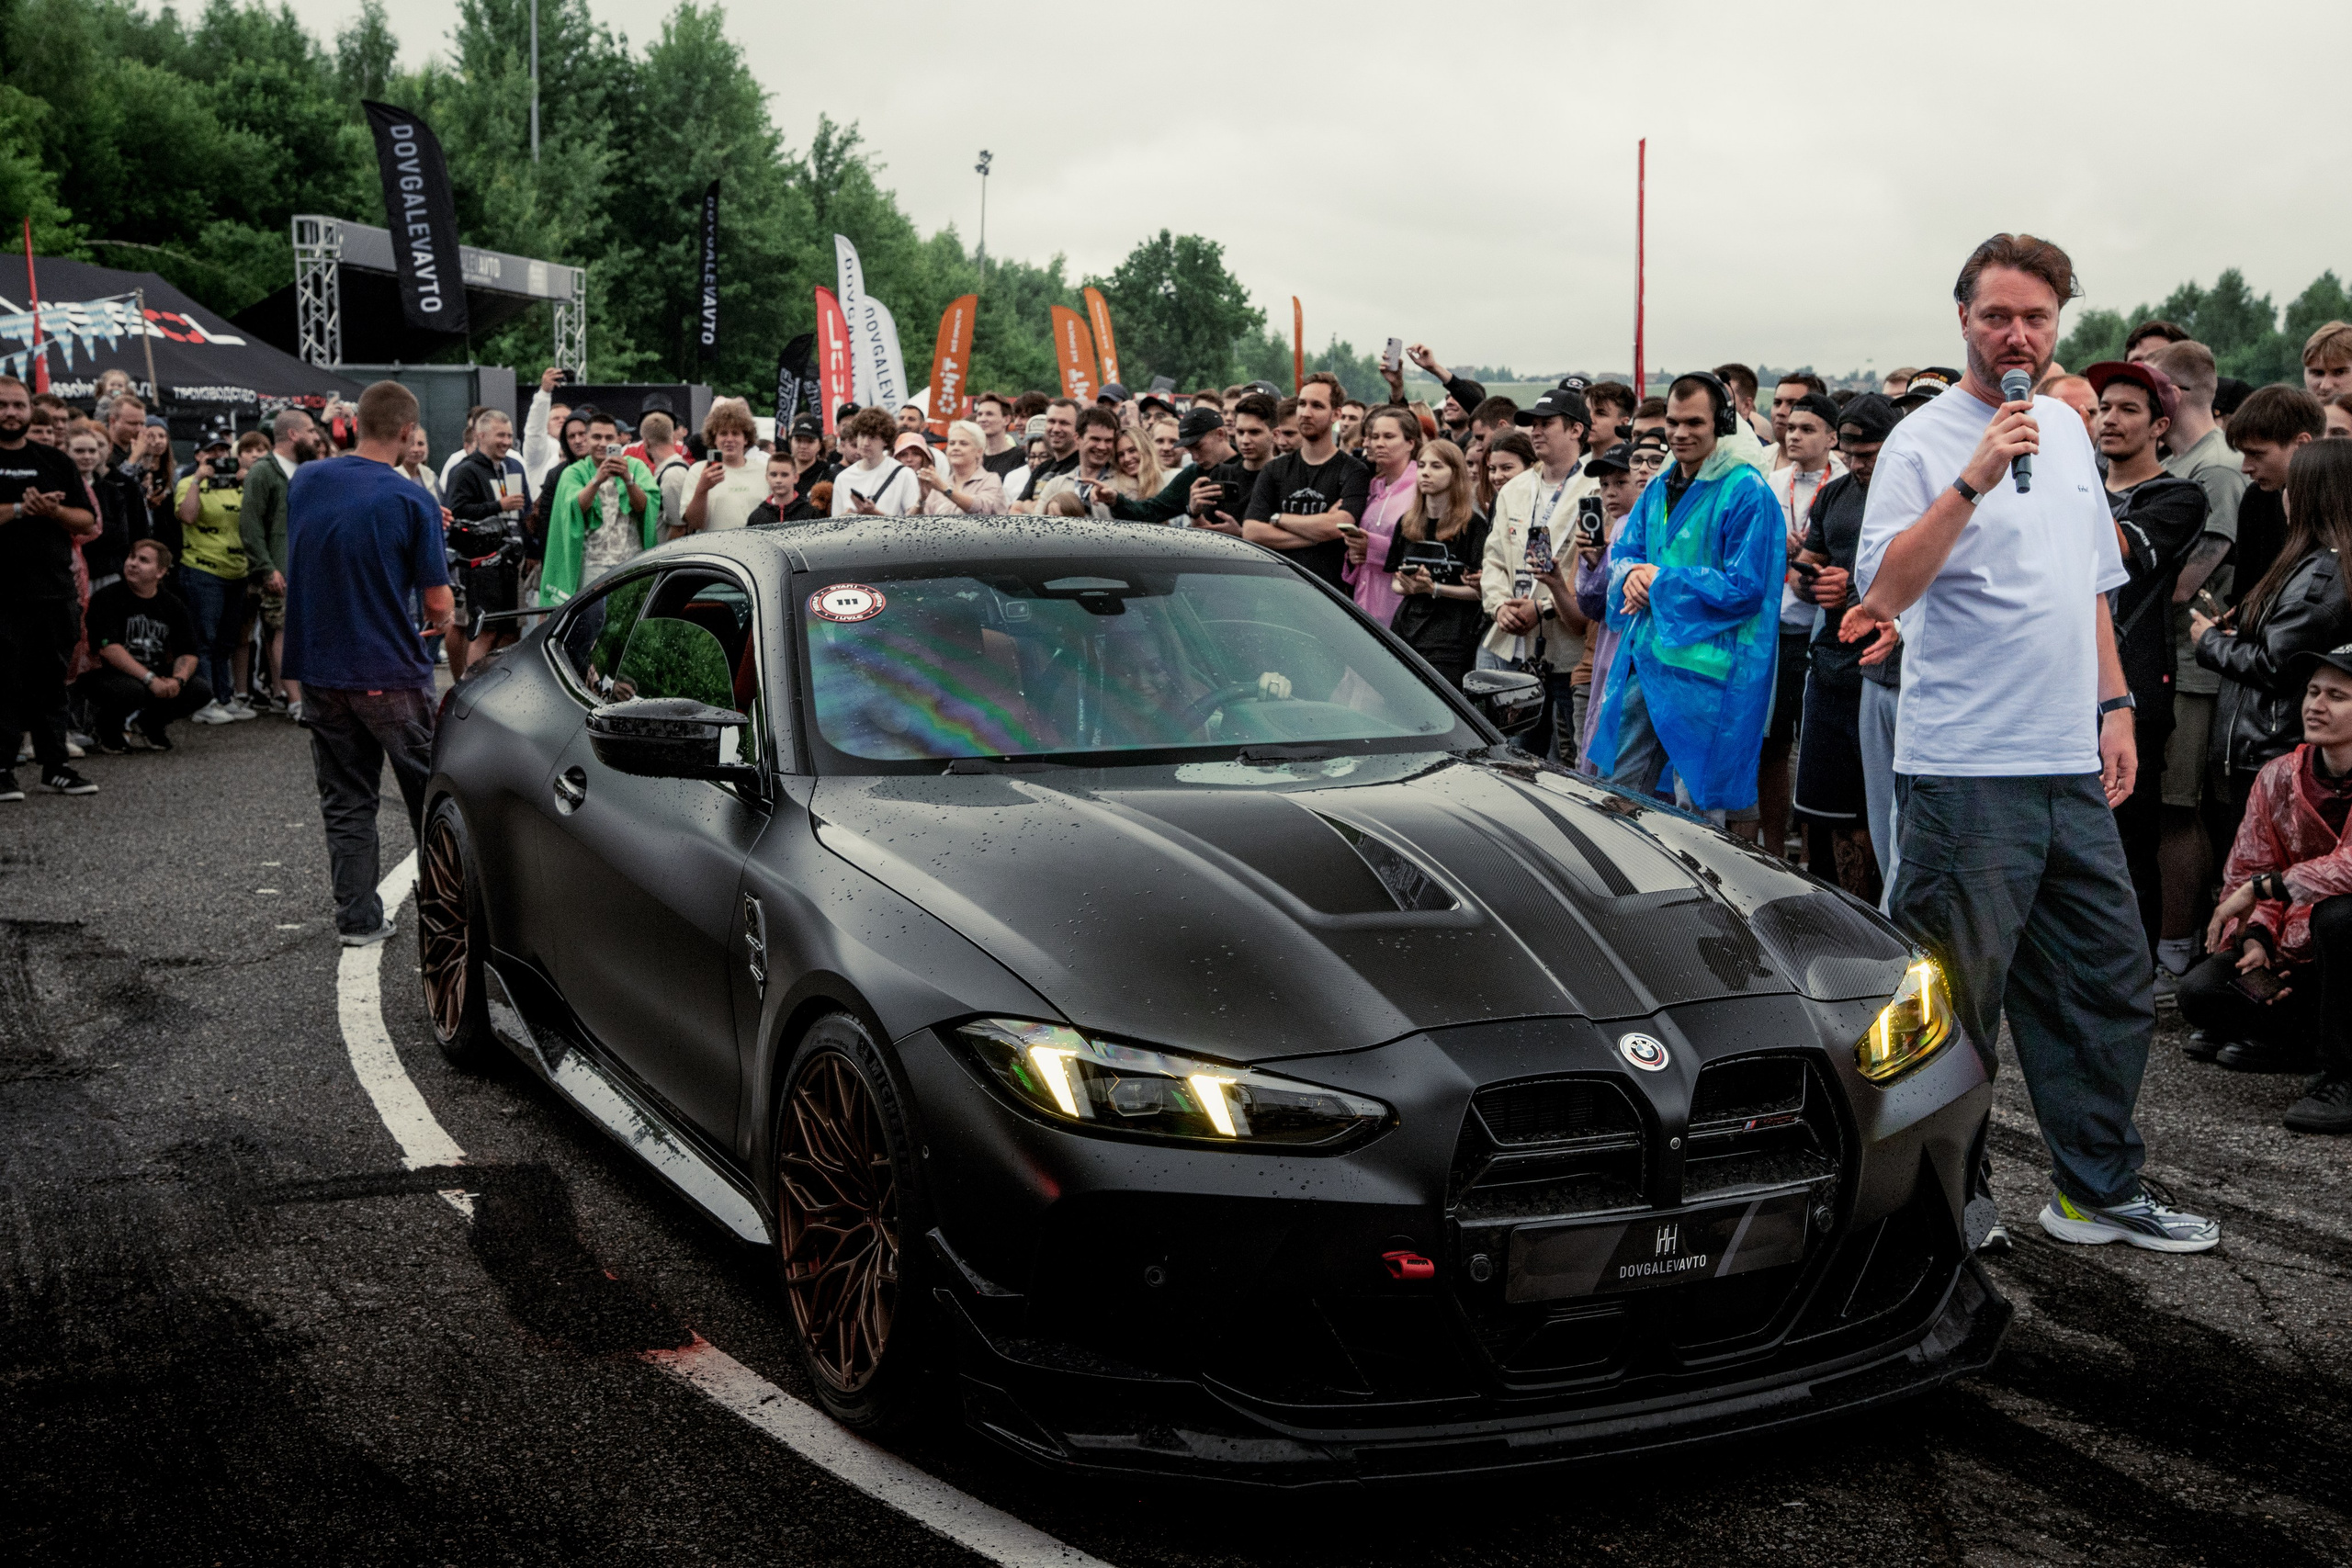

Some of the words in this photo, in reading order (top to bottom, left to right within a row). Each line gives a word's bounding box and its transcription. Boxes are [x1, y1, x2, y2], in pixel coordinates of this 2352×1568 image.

[390, 124, 443, 313] DOVGALEVAVTO
[701, 196, 718, 345] DOVGALEVAVTO
[865, 307, 898, 414] DOVGALEVA
[803, 378, 822, 420] OLF
[836, 598, 859, 606] 111
[1631, 1039, 1653, 1049] BMW
[1620, 1254, 1707, 1279] DOVGALEVAVTO
